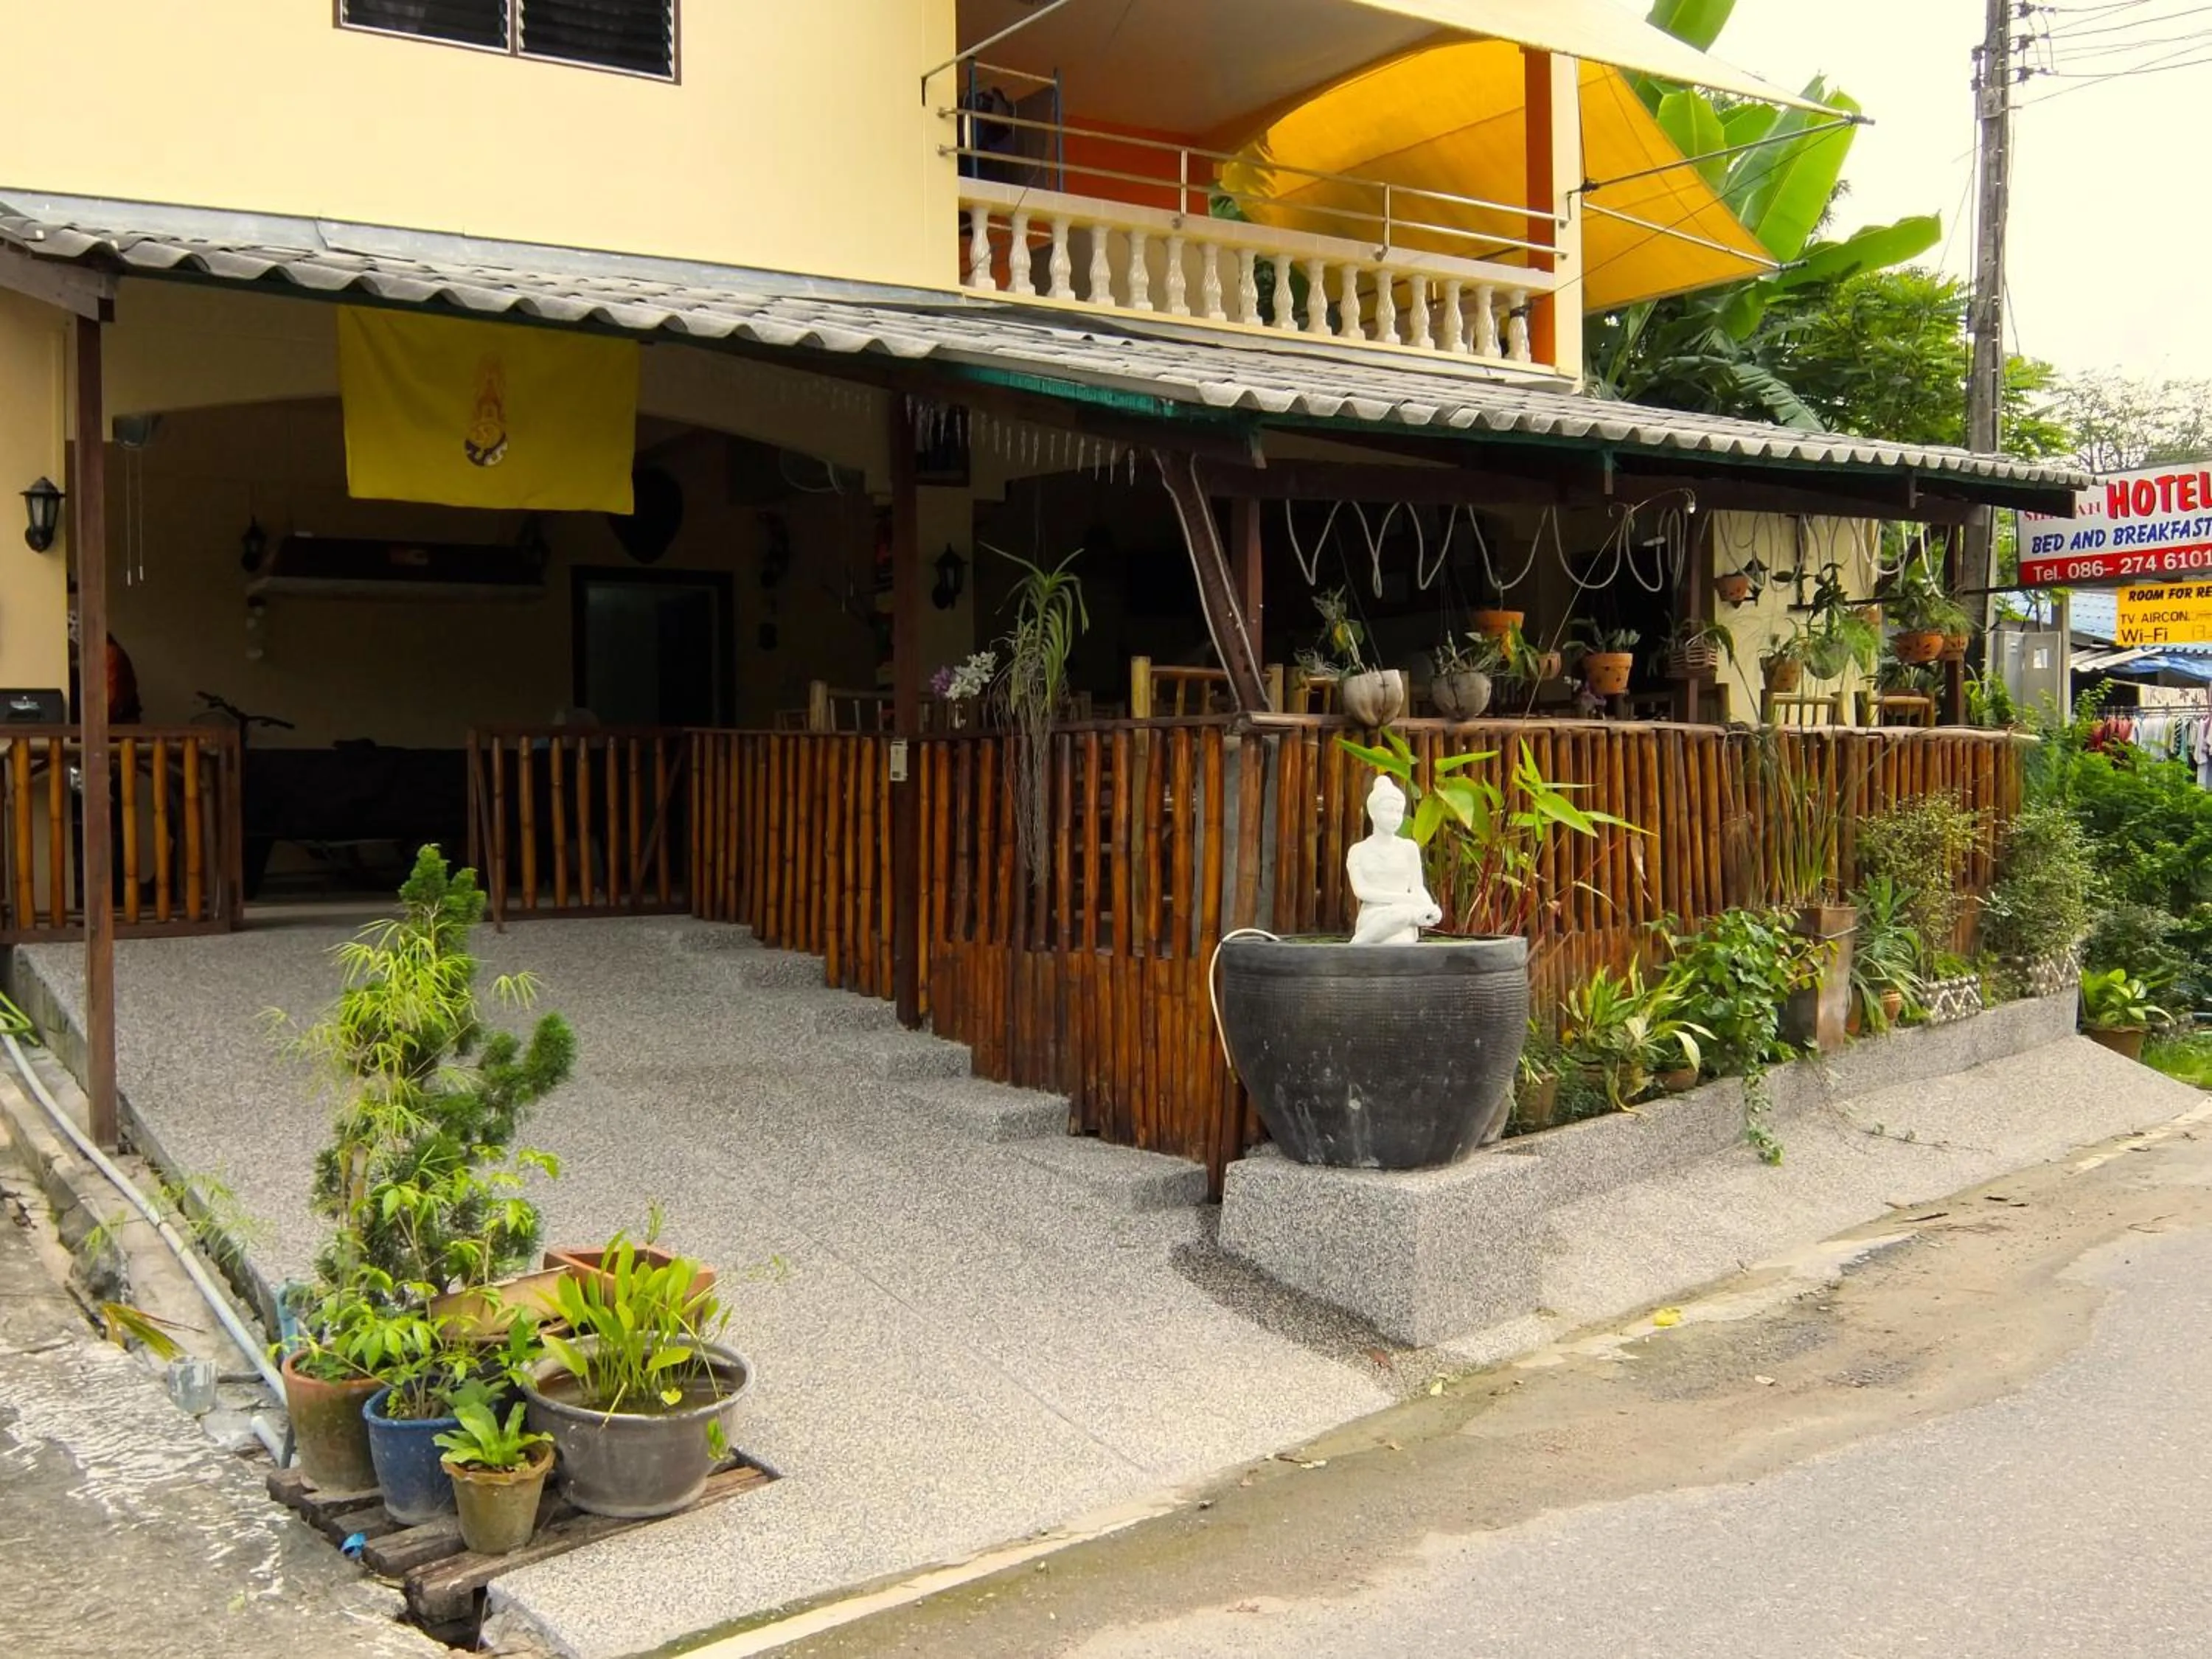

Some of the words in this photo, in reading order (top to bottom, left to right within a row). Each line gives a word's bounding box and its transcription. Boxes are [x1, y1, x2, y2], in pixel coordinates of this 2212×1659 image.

[2106, 471, 2212, 519] HOTEL
[2031, 533, 2065, 554] BED
[2070, 529, 2106, 550] AND
[2112, 517, 2212, 546] BREAKFAST
[2033, 565, 2062, 582] Tel.
[2120, 554, 2157, 574] 274
[2164, 549, 2212, 570] 6101
[2128, 589, 2164, 602] ROOM
[2168, 587, 2193, 599] FOR
[2121, 613, 2136, 625] TV
[2121, 627, 2168, 643] Wi-Fi
